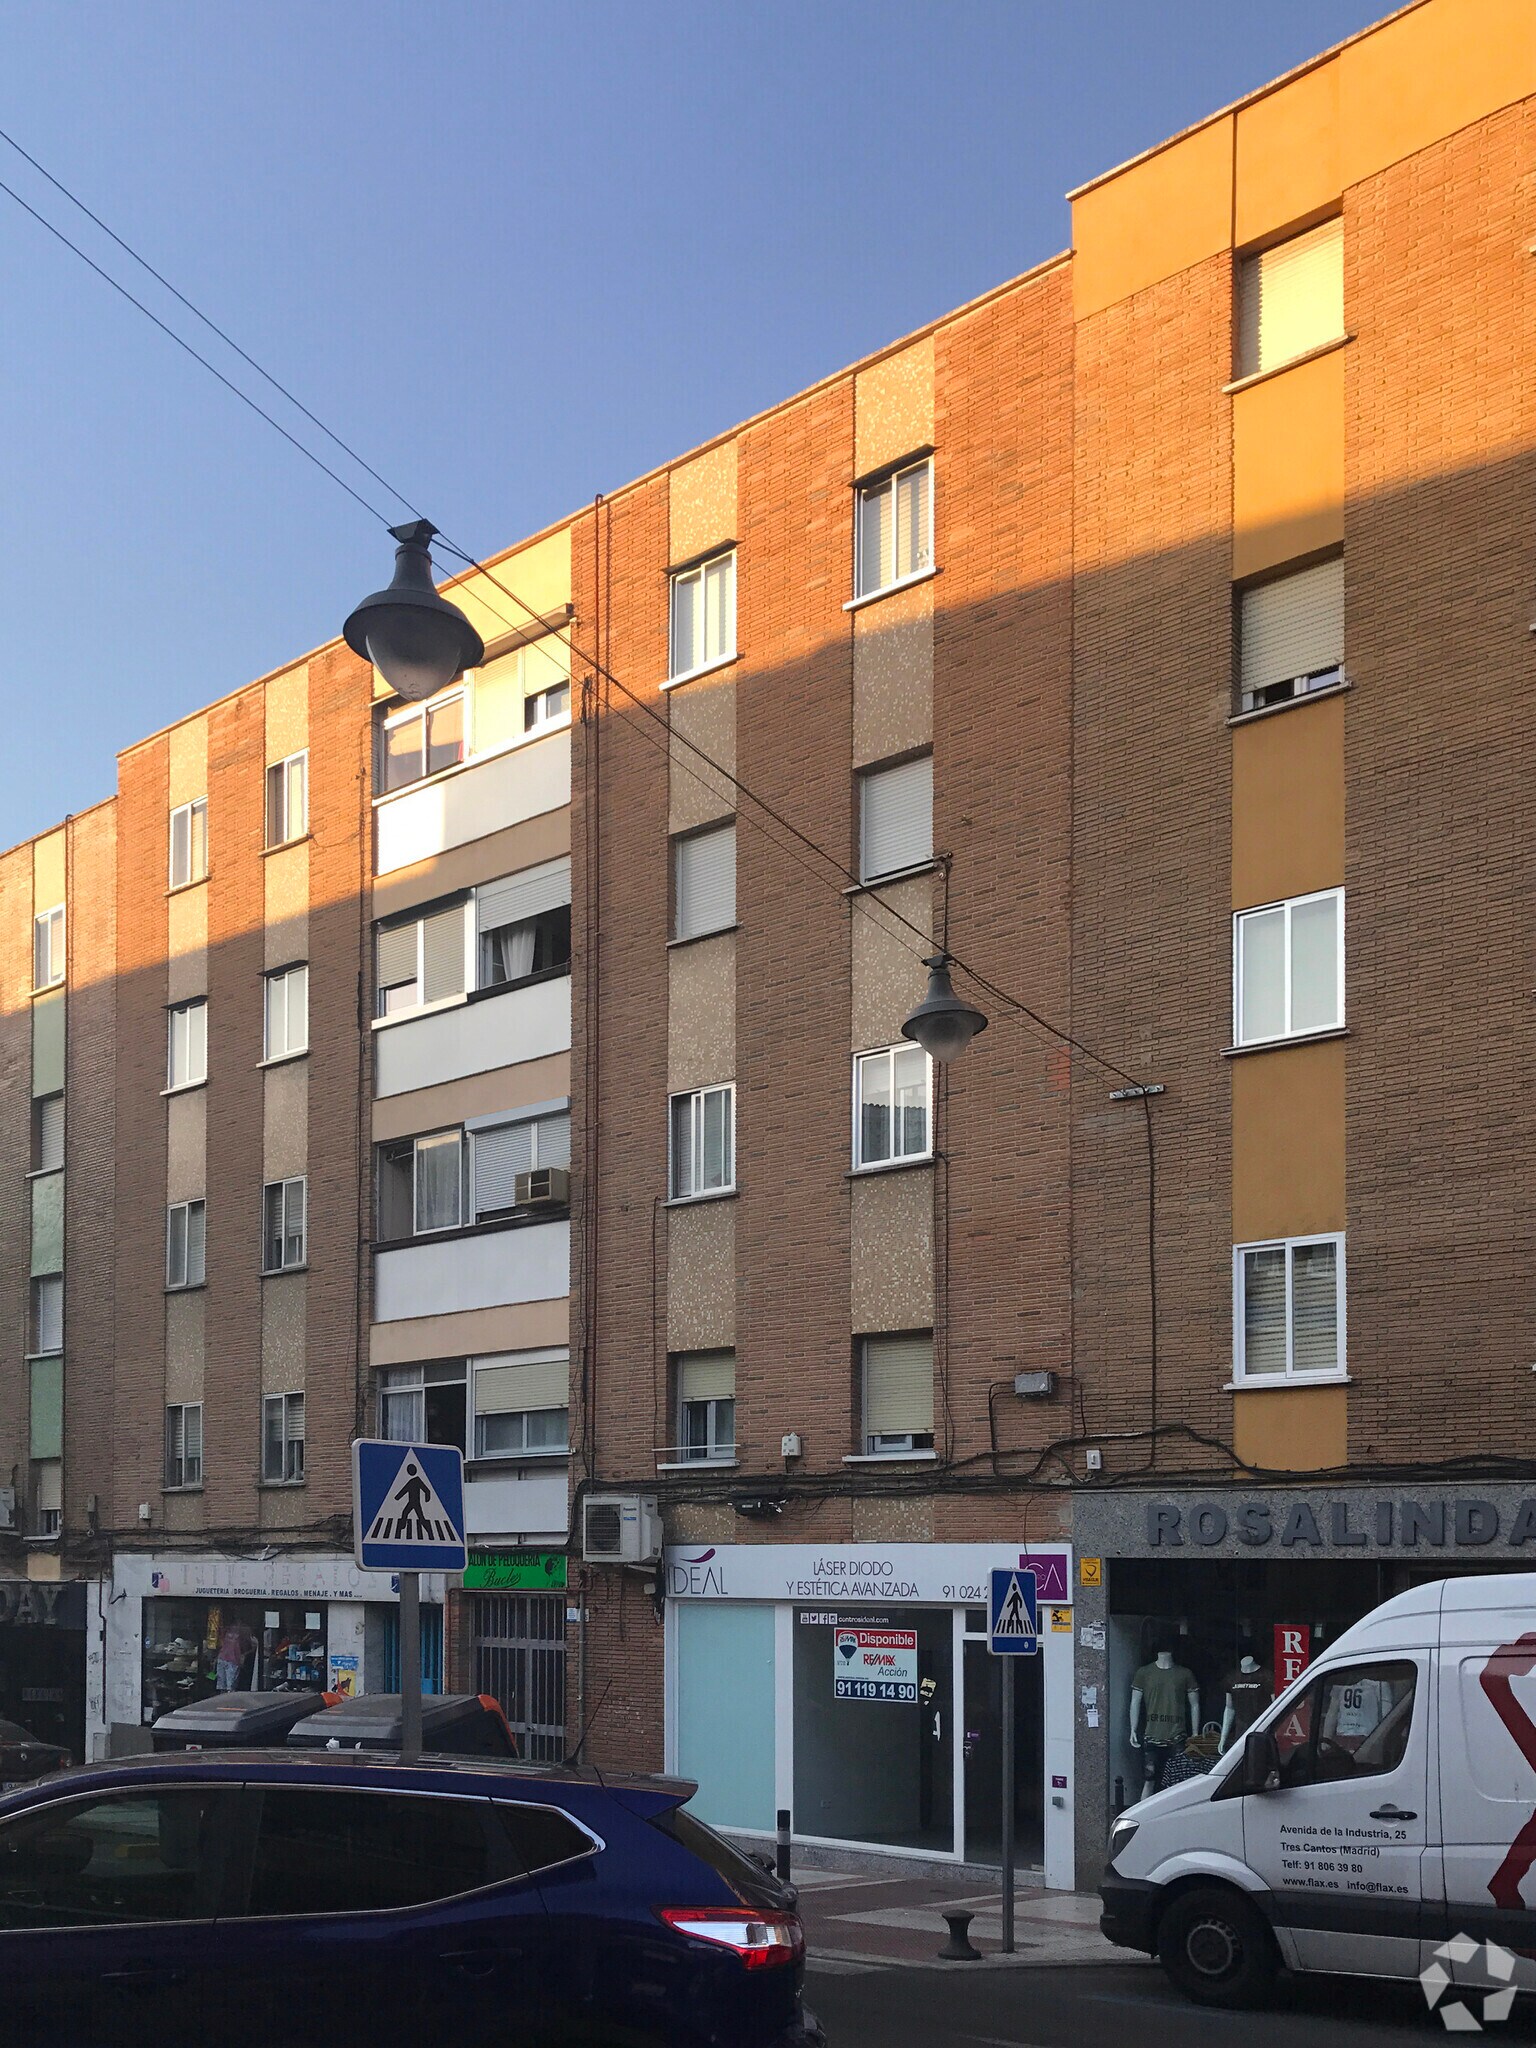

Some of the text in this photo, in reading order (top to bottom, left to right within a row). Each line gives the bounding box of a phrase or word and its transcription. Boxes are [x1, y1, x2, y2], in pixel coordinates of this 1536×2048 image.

[1147, 1501, 1536, 1546] ROSALINDA
[813, 1558, 894, 1576] LÁSER DIODO
[668, 1566, 729, 1595] IDEAL
[786, 1578, 920, 1597] Y ESTÉTICA AVANZADA
[195, 1587, 230, 1595] JUGUETERIA
[271, 1589, 299, 1597] REGALOS
[303, 1590, 329, 1598] MENAJE
[942, 1585, 956, 1599] 91
[959, 1585, 982, 1599] 024
[859, 1632, 914, 1647] Disponible
[863, 1653, 897, 1667] RE/MAX
[877, 1665, 908, 1678] Acción
[837, 1681, 915, 1700] 91 119 14 90
[1343, 1688, 1363, 1709] 96
[1280, 1824, 1407, 1840] Avenida de la Industria, 25
[1280, 1842, 1380, 1858] Tres Cantos (Madrid)
[1281, 1859, 1363, 1873] Telf: 91 806 39 80
[1282, 1877, 1409, 1894] www.flax.es info@flax.es
